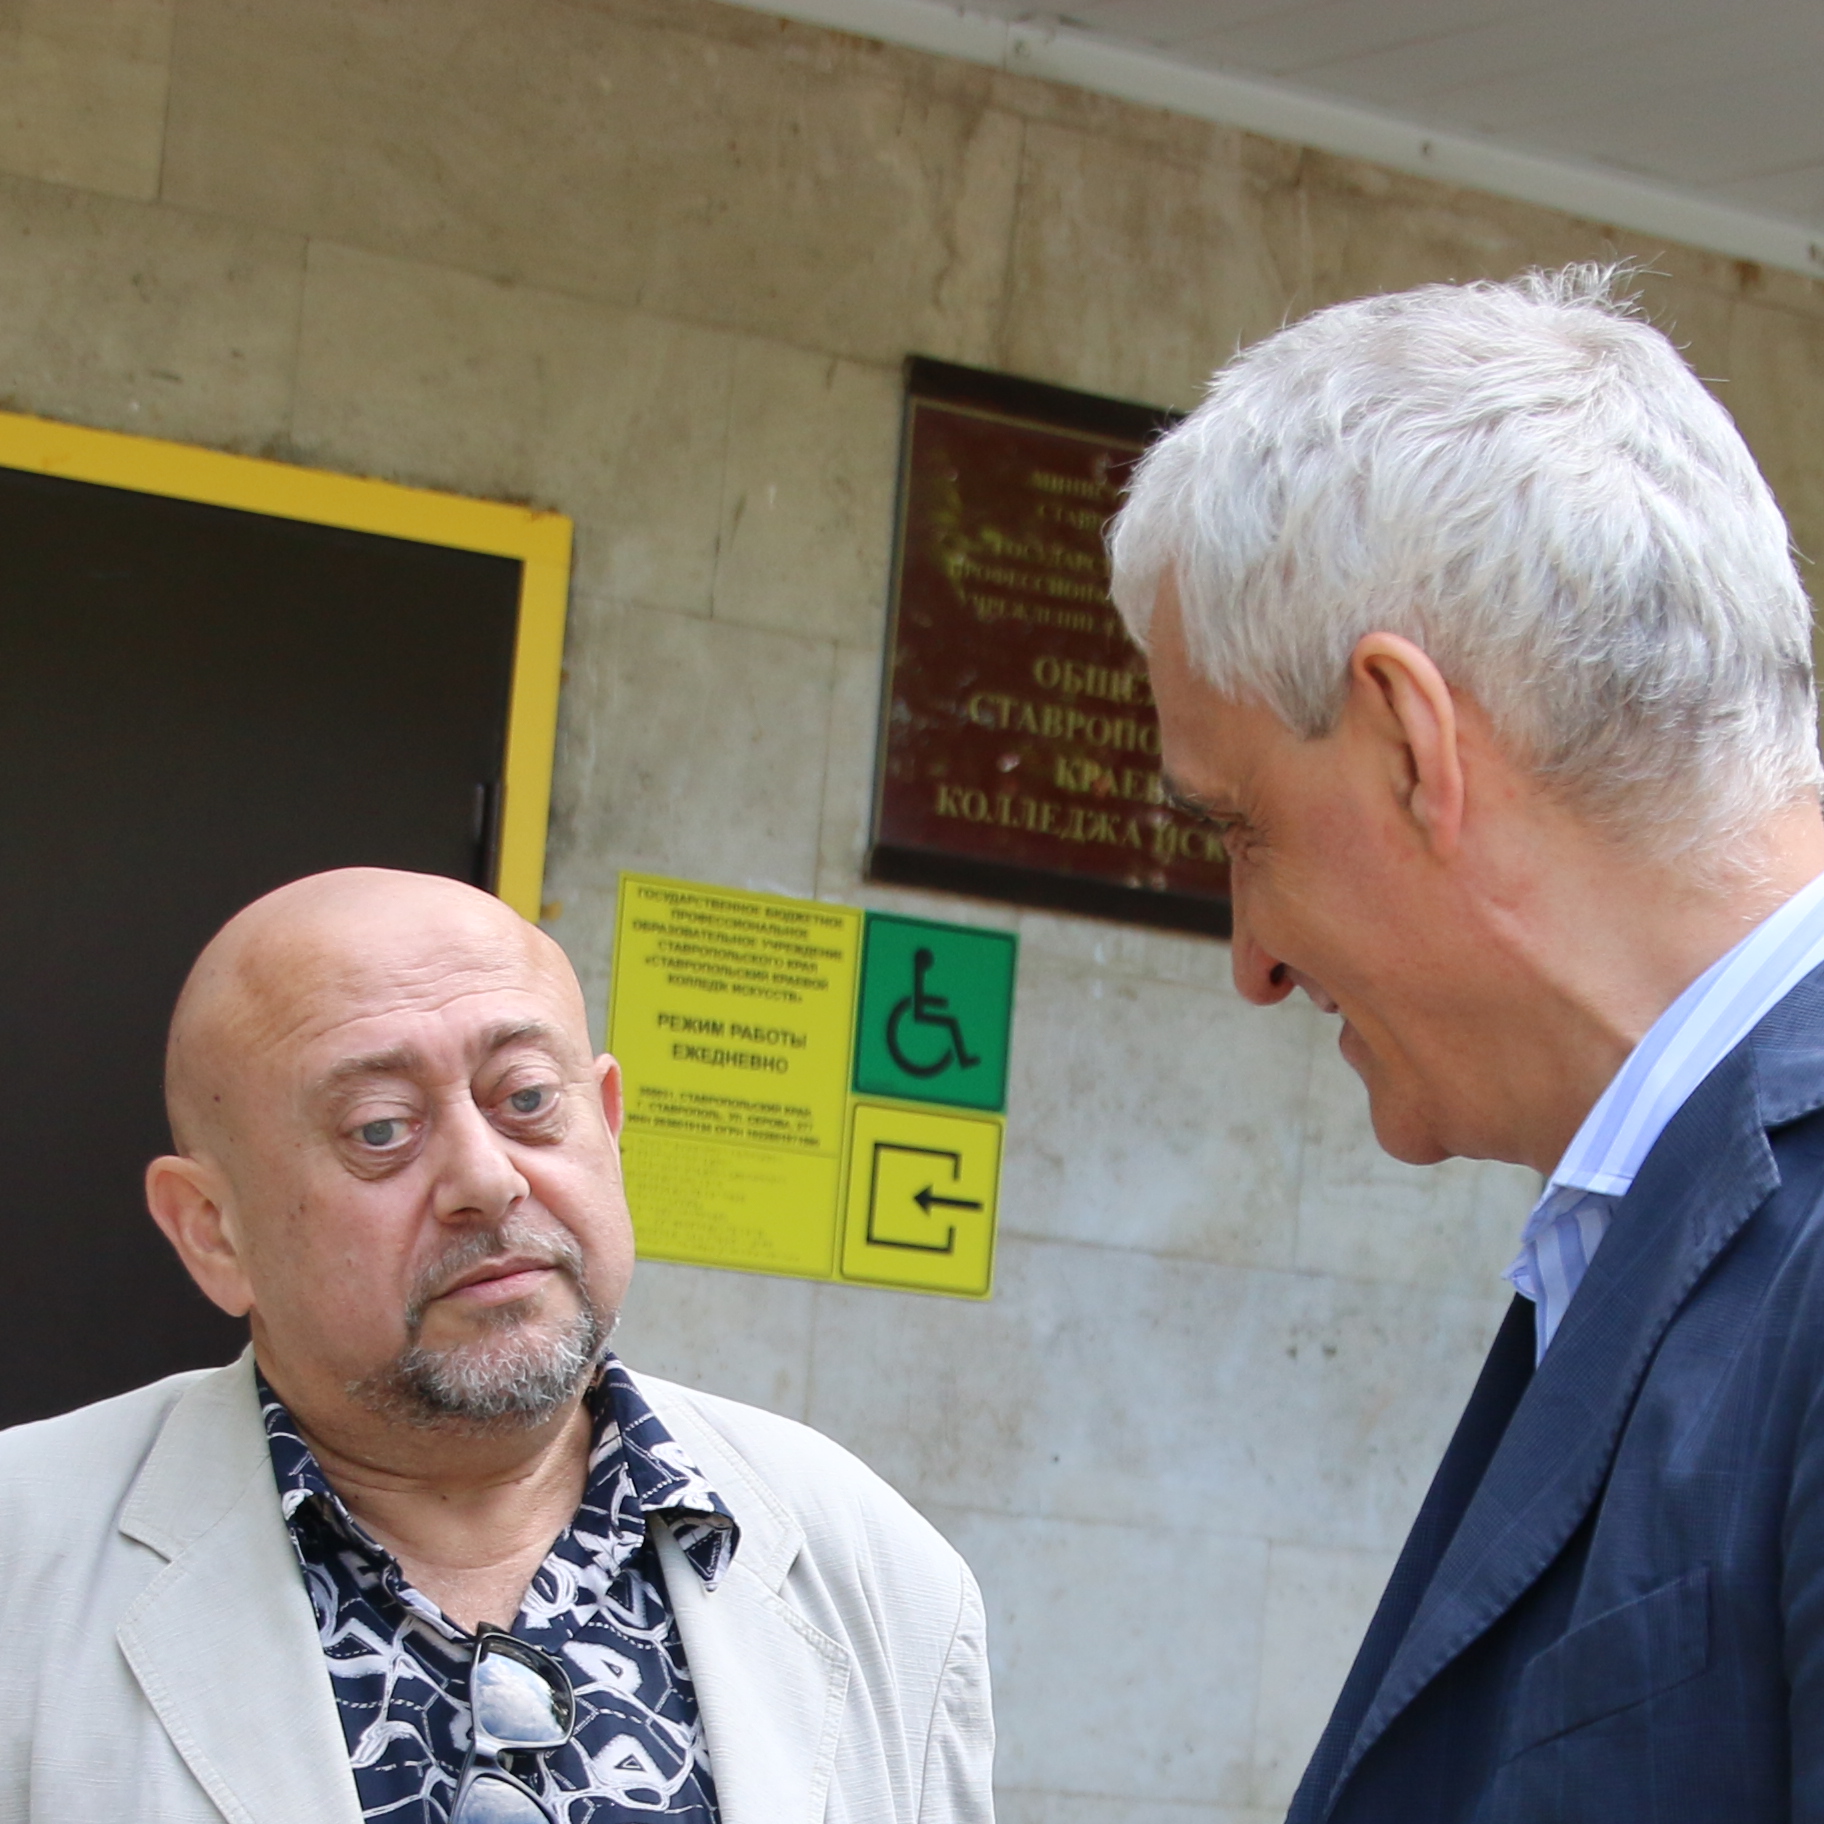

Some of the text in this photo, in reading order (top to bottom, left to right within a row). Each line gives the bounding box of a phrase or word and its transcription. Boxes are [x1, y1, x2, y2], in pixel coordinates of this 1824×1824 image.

[1032, 655, 1156, 706] ОБЩЕ
[968, 690, 1162, 756] СТАВРОПО
[1053, 755, 1166, 805] КРАЕВ
[935, 784, 1226, 864] КОЛЛЕДЖА ИСК
[638, 888, 843, 928] ГОСУДАРСТВЕННОЕ БЮДЖЕТНОЕ
[671, 908, 808, 938] ПРОФЕССИОНАЛЬНОЕ
[632, 920, 843, 960] ОБРАЗОВАТЕЛЬНОЕ УЧРЕЖДЕНИЕ
[658, 939, 818, 974] СТАВРОПОЛЬСКОГО КРАЯ
[667, 973, 727, 993] КОЛЛЕДЖ
[772, 971, 828, 990] КРАЕВОЙ
[657, 1012, 807, 1049] РЕЖИМ РАБОТЫ
[672, 1043, 789, 1074] ЕЖЕДНЕВНО
